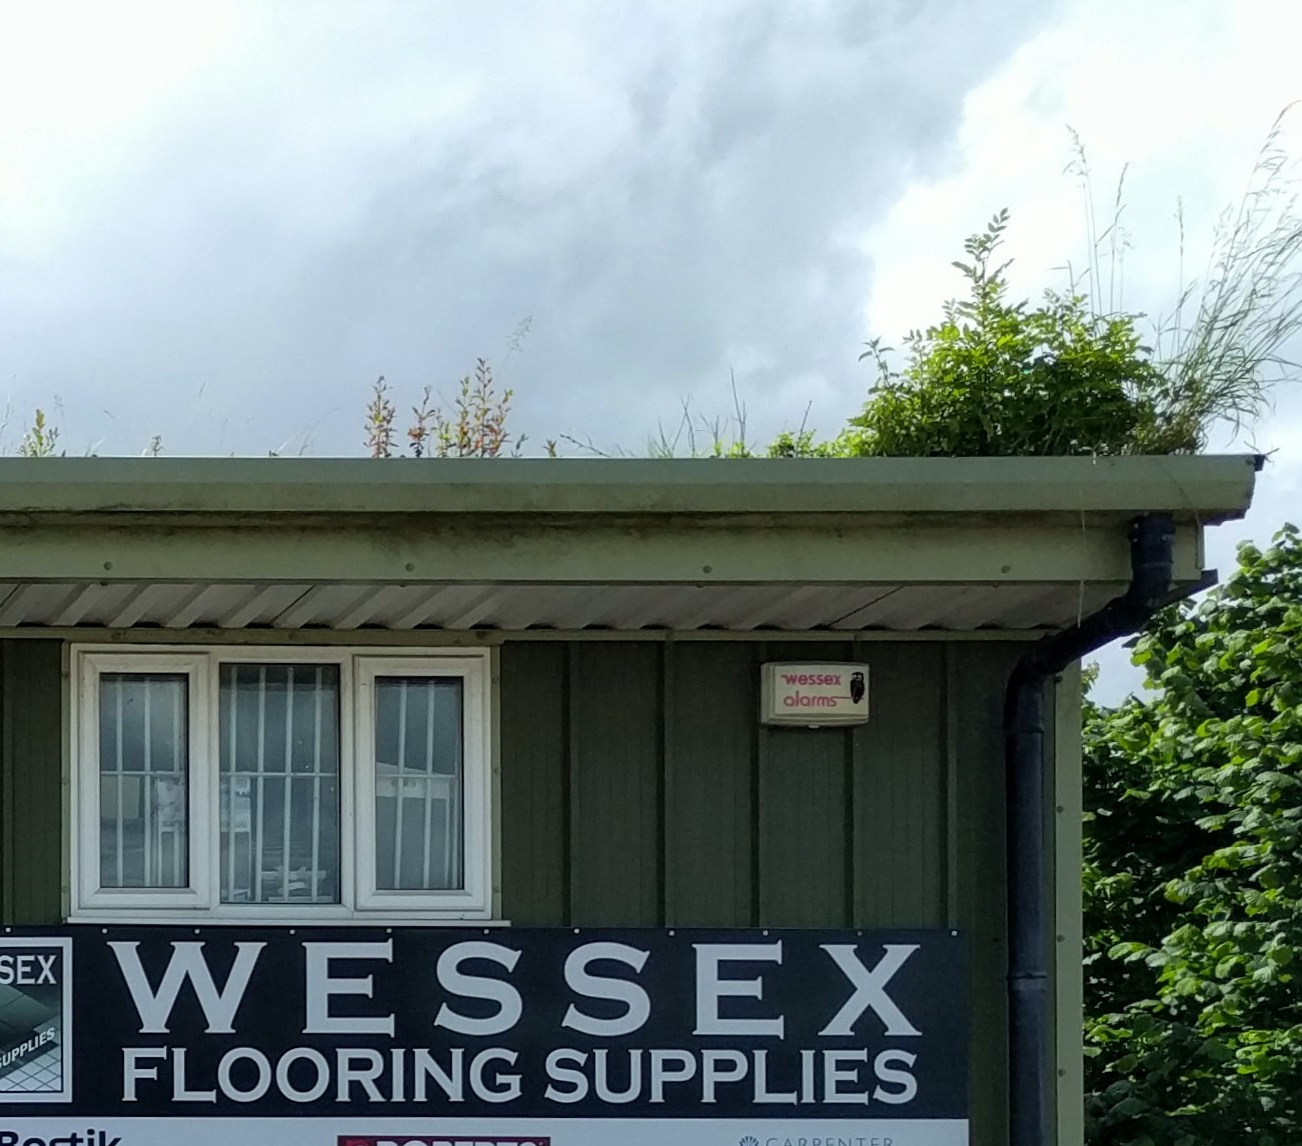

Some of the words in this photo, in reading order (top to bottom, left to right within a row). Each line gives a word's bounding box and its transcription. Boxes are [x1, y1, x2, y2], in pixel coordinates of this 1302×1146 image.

[781, 674, 842, 686] wessex
[783, 690, 838, 707] alarms
[107, 938, 923, 1040] WESSEX
[122, 1046, 523, 1103] FLOORING
[544, 1048, 918, 1105] SUPPLIES
